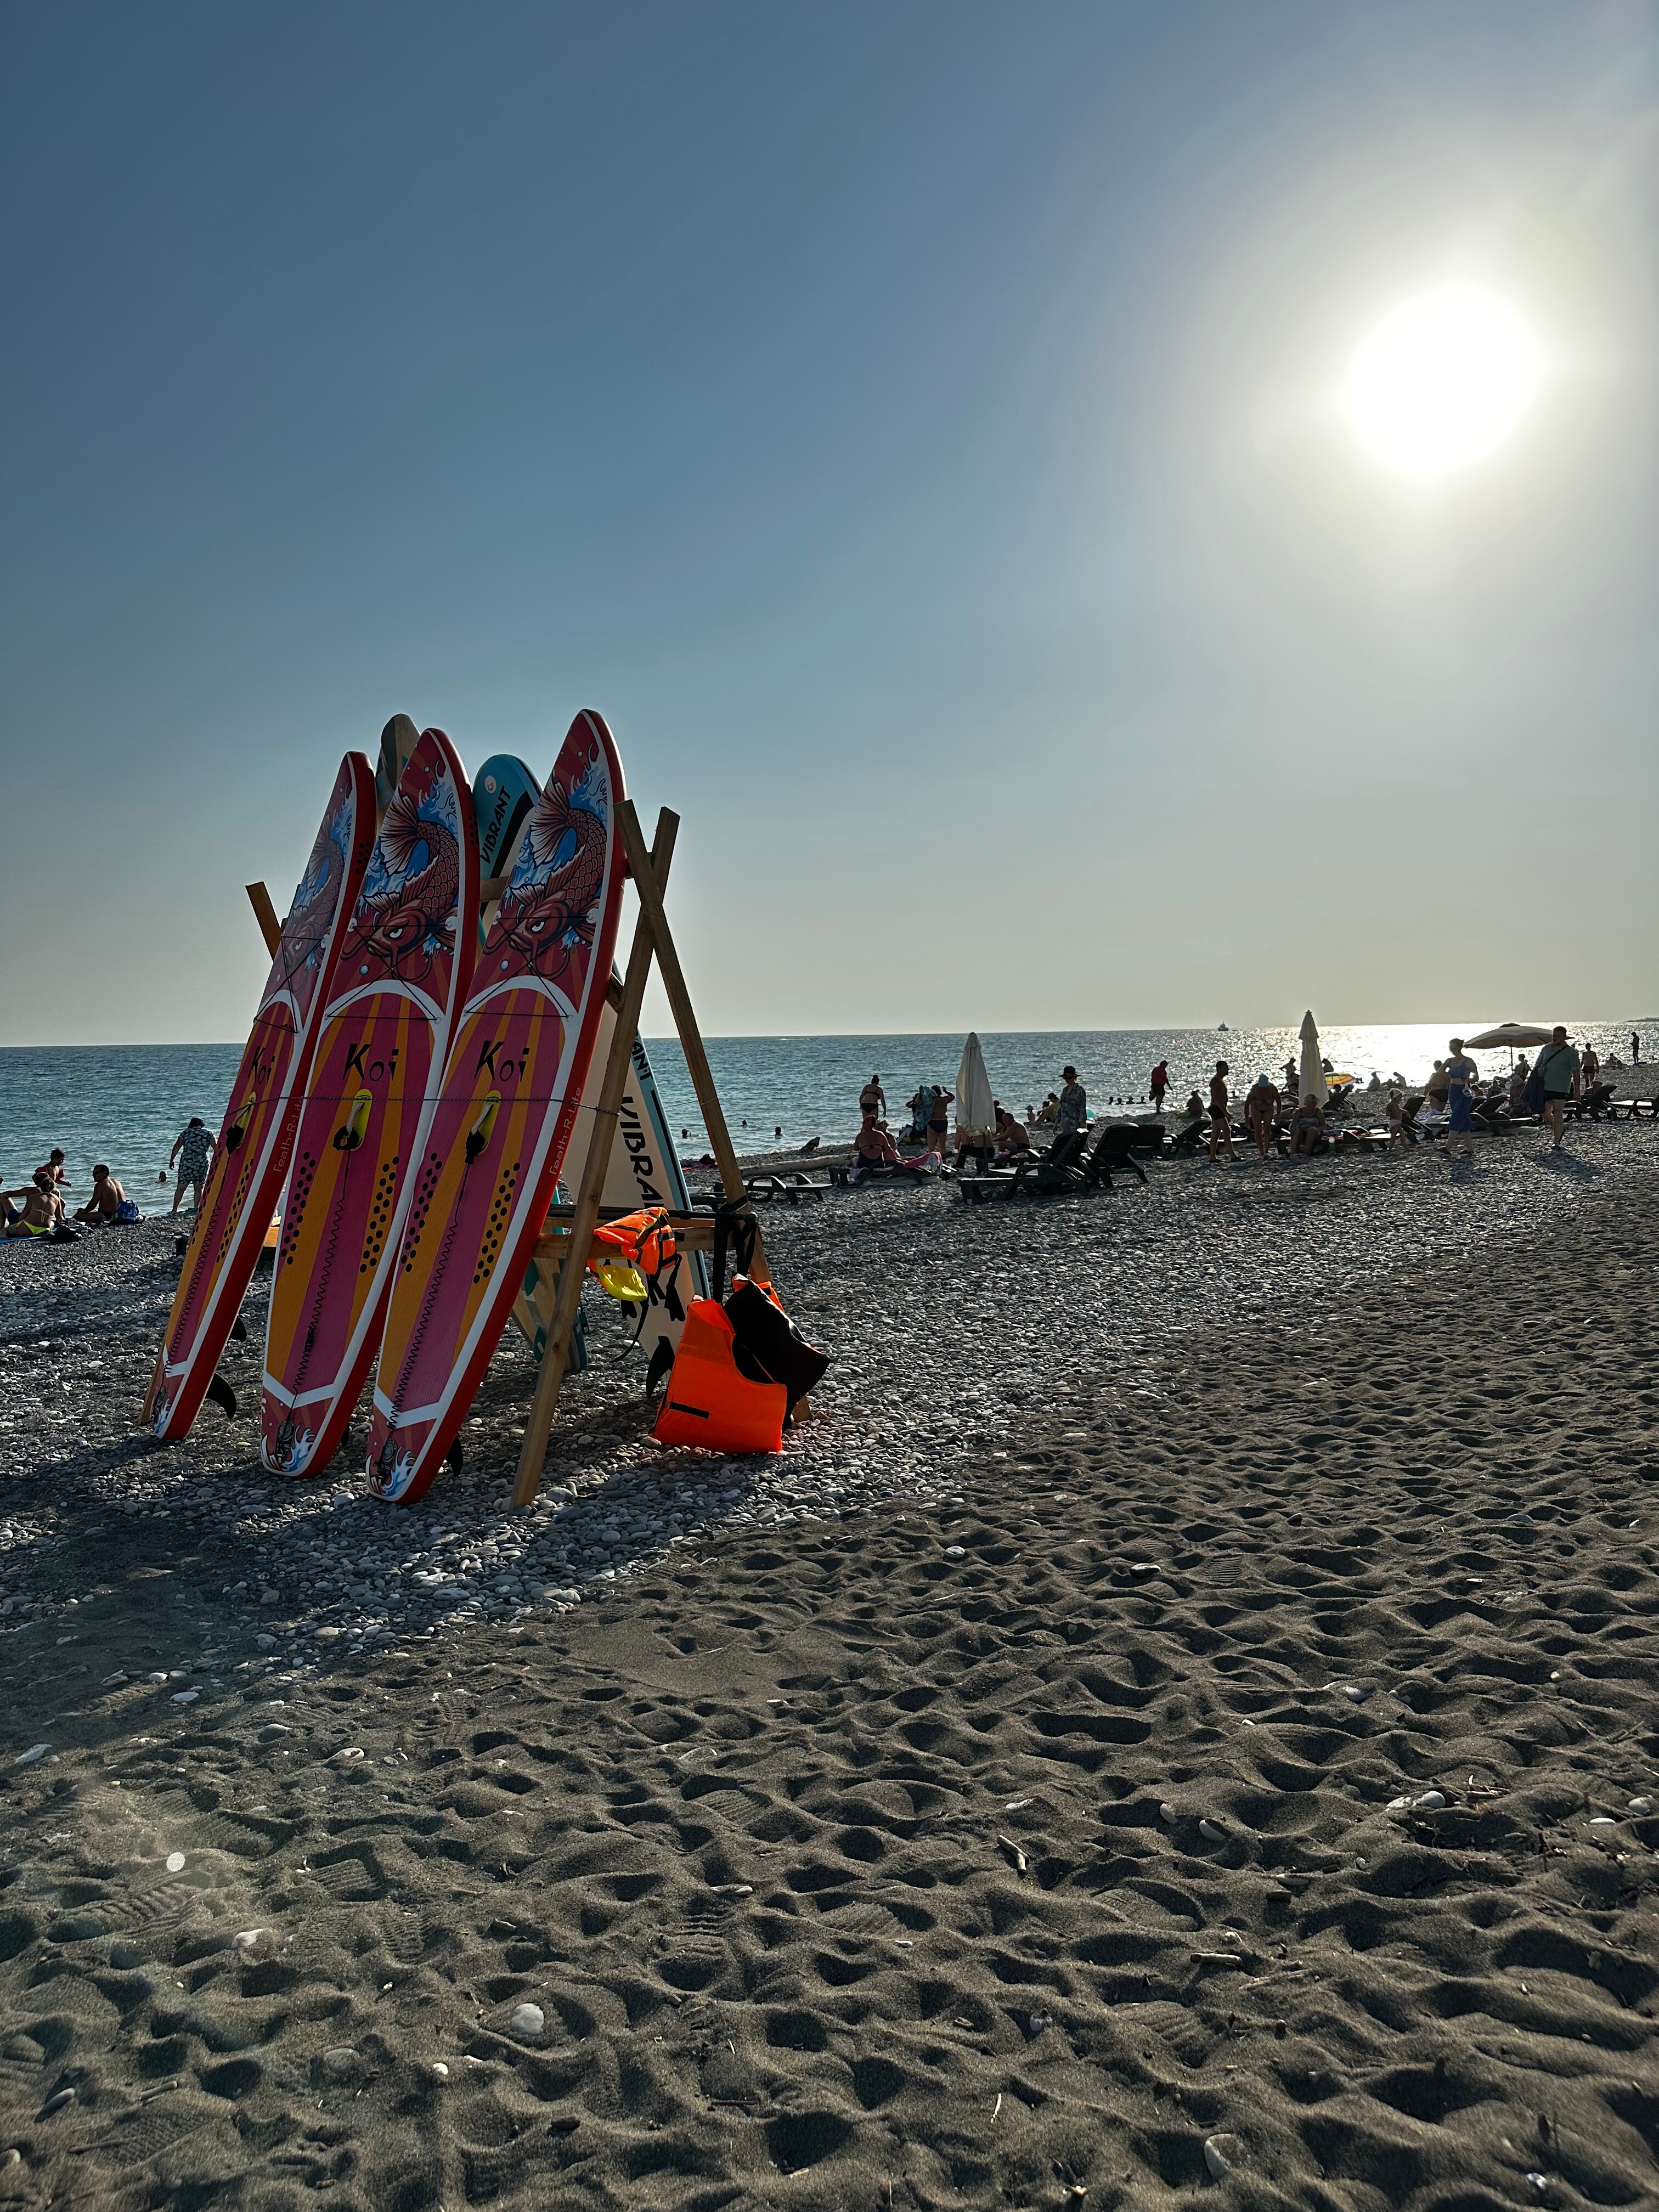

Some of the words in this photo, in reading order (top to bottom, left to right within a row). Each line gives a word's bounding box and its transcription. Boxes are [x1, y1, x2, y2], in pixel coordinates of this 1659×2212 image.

[481, 785, 511, 864] VIBRANT
[248, 1046, 275, 1086] Koi
[342, 1043, 399, 1082] Koi
[474, 1040, 530, 1082] Koi
[549, 1087, 582, 1175] Feath-R-Lite
[619, 1096, 665, 1208] VIBRA
